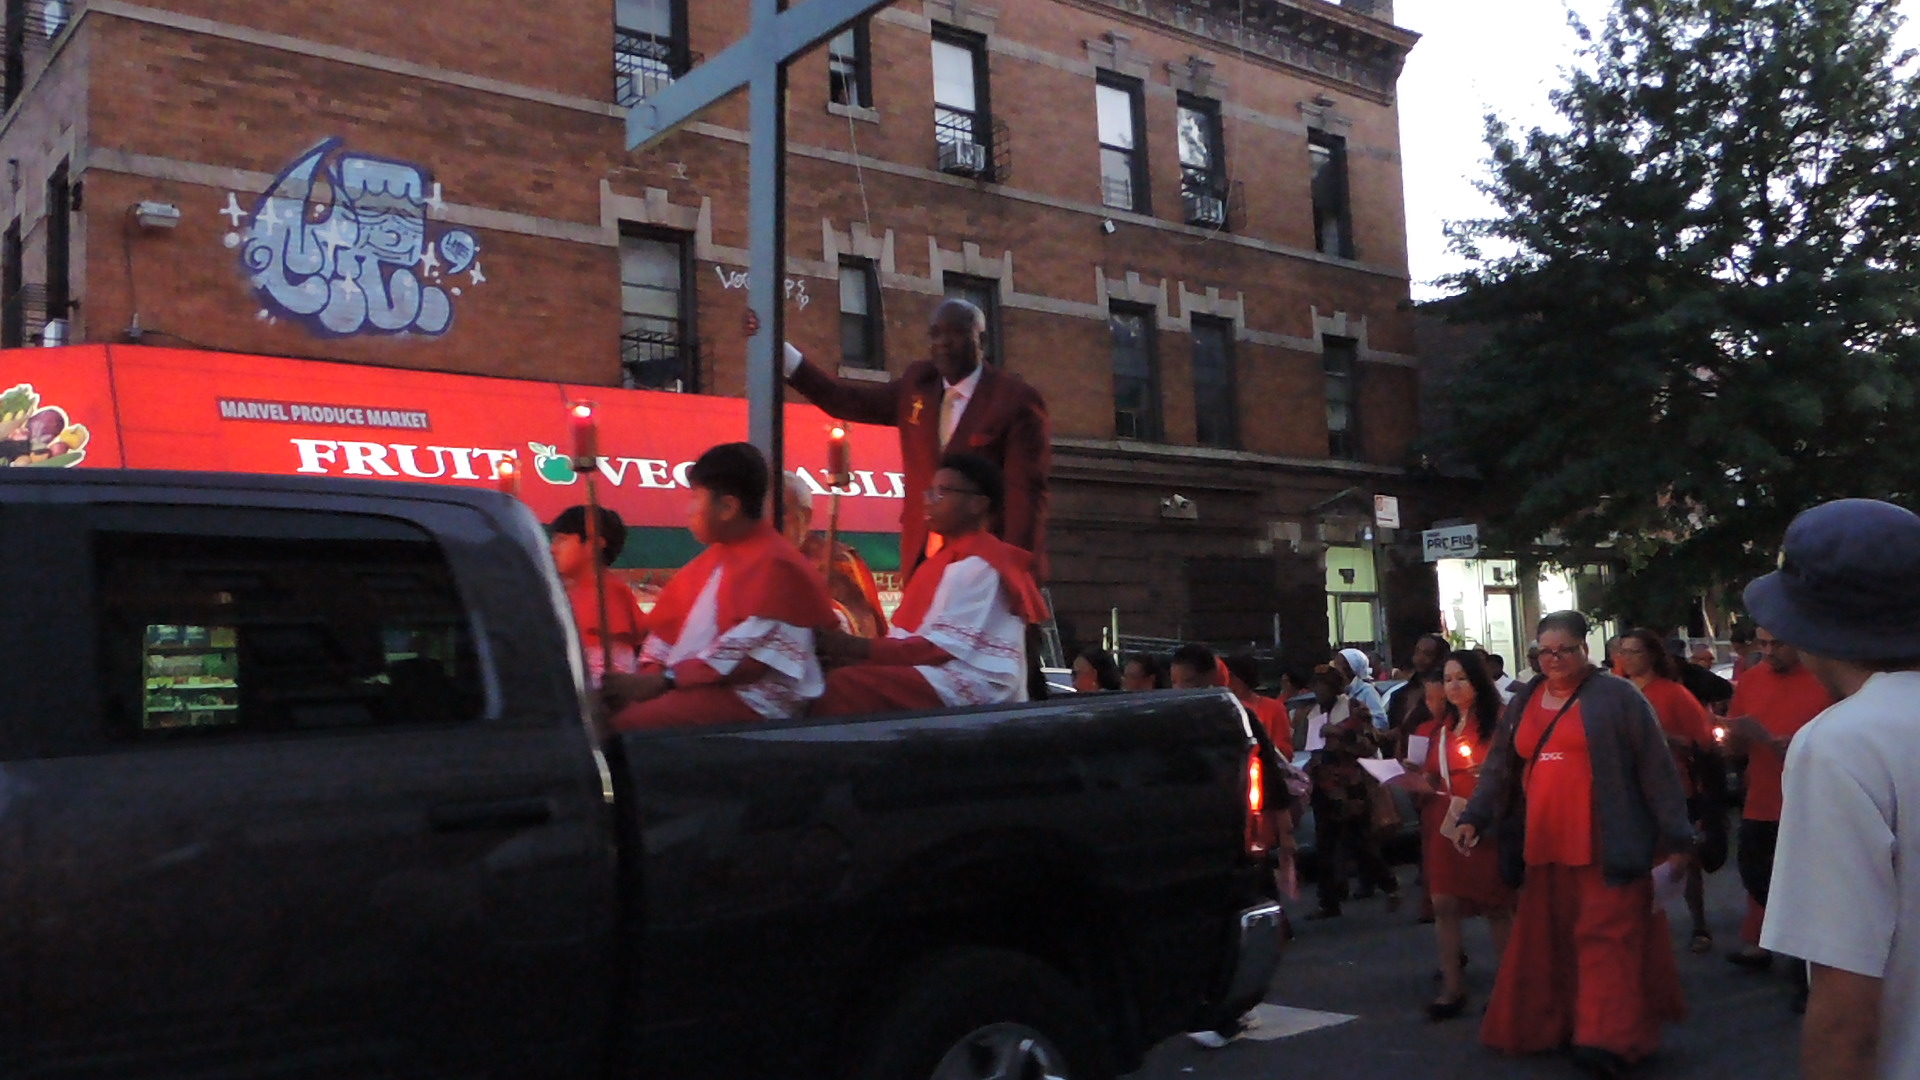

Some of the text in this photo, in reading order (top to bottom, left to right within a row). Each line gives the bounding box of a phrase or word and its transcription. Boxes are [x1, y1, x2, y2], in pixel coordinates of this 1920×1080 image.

[220, 401, 428, 428] MARVEL PRODUCE MARKET
[290, 438, 517, 480] FRUIT
